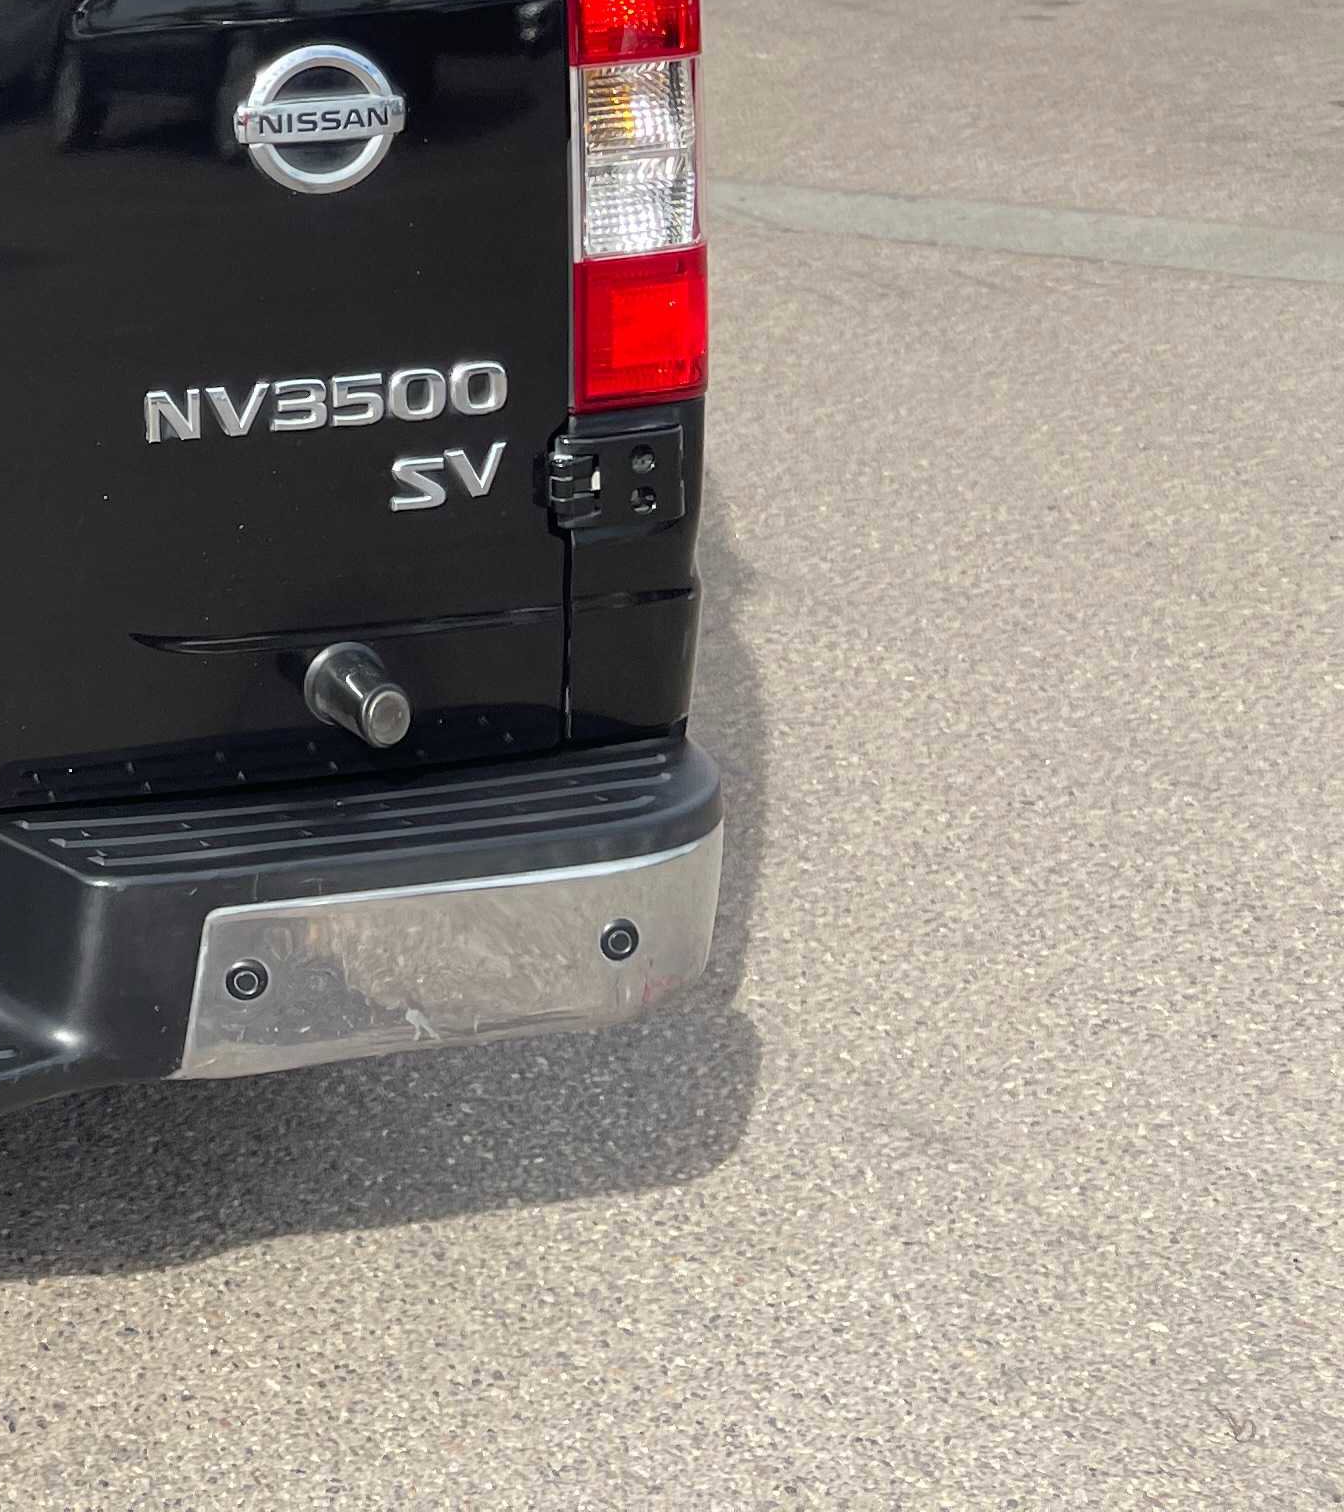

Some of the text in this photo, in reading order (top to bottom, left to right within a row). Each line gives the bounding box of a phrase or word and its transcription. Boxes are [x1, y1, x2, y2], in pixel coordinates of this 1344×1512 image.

[259, 106, 389, 135] NISSAN
[144, 360, 508, 444] NV3500
[390, 441, 507, 512] SV
